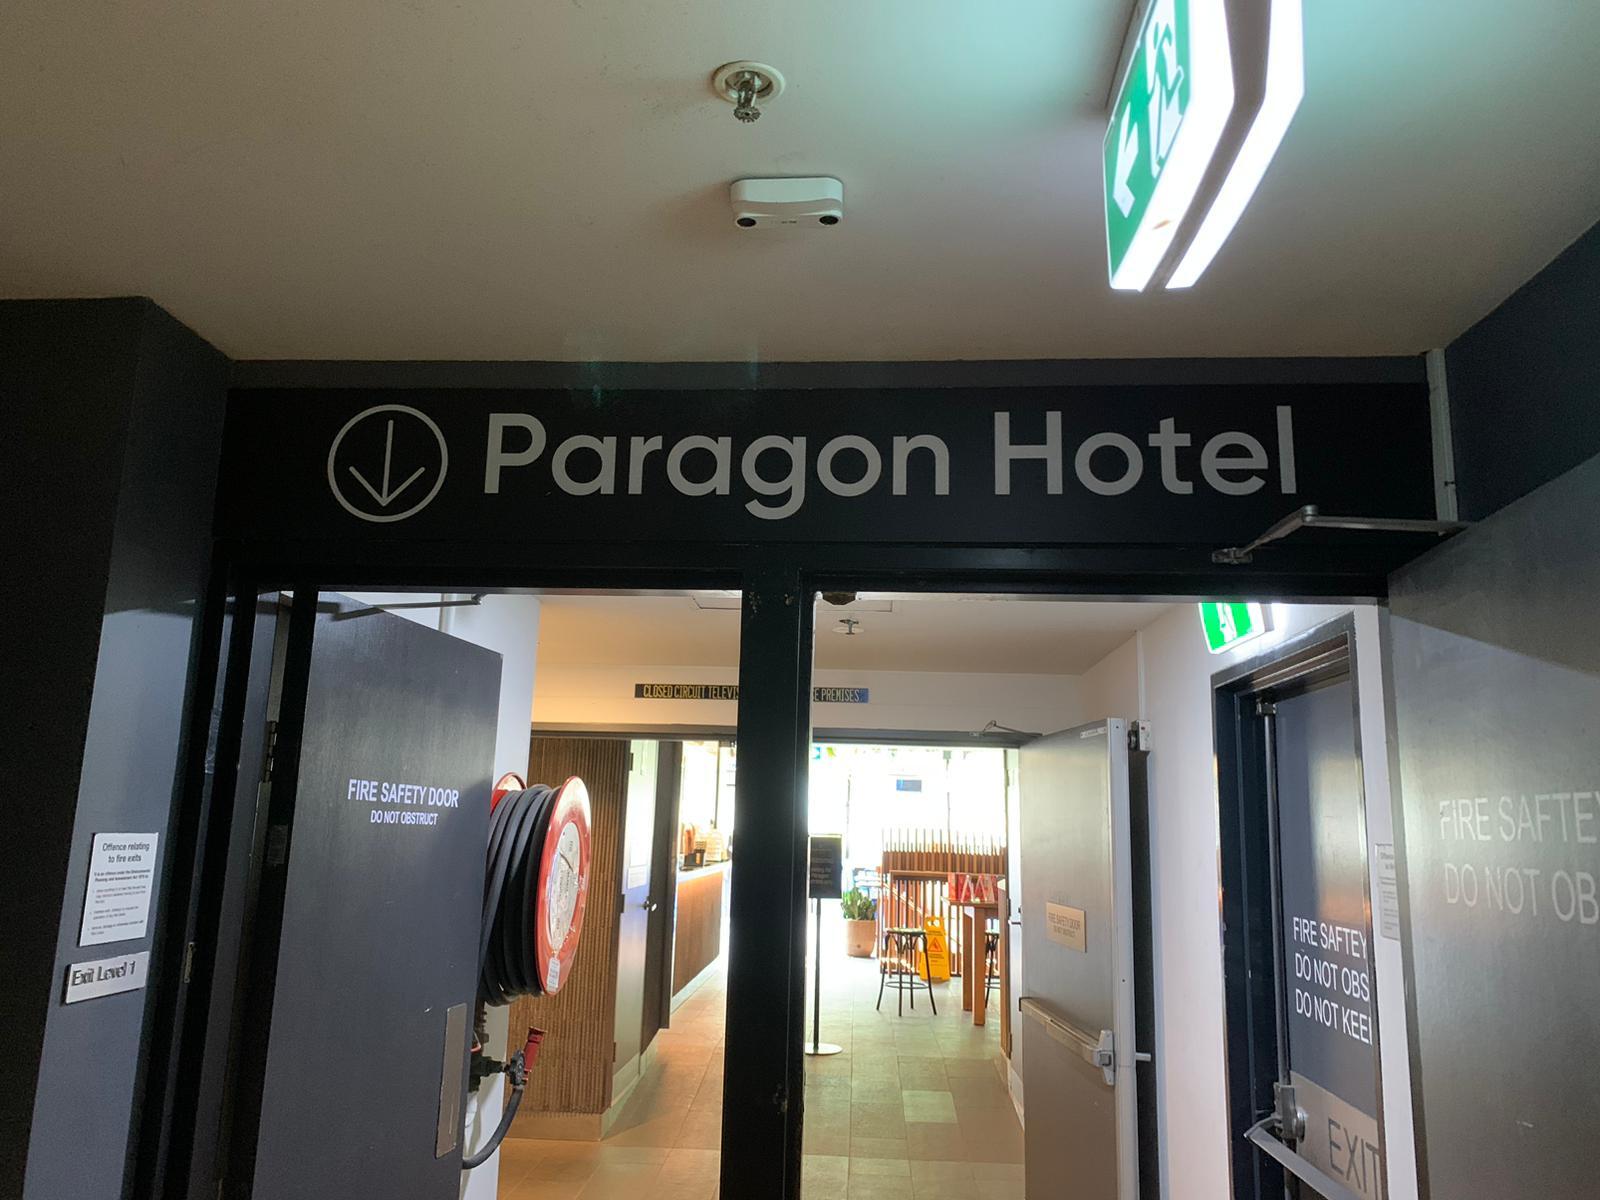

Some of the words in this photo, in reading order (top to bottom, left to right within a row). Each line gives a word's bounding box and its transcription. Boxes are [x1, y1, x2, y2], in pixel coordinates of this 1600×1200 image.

[484, 413, 950, 520] Paragon
[994, 405, 1297, 496] Hotel
[643, 685, 673, 698] CLOSED
[674, 685, 705, 698] CIRCUIT
[821, 688, 860, 702] PREMISES
[347, 779, 379, 802] FIRE
[380, 782, 426, 805] SAFETY
[428, 787, 460, 808] DOOR
[370, 810, 383, 823] DO
[383, 811, 400, 824] NOT
[400, 812, 438, 825] OBSTRUCT
[1439, 798, 1491, 841] FIRE
[1499, 791, 1600, 844] SAFTE
[102, 843, 127, 851] Offence
[127, 842, 150, 851] relating
[1444, 863, 1478, 907] DO
[1485, 867, 1540, 917] NOT
[1293, 917, 1318, 947] FIRE
[71, 968, 94, 986] Exit
[96, 962, 127, 981] Level
[129, 960, 136, 975] 1
[1295, 953, 1312, 982] DO
[1314, 959, 1338, 991] NOT
[1295, 988, 1312, 1018] DO
[1314, 995, 1339, 1030] NOT
[1341, 1006, 1373, 1046] KEE
[1328, 1117, 1381, 1200] EXIT
